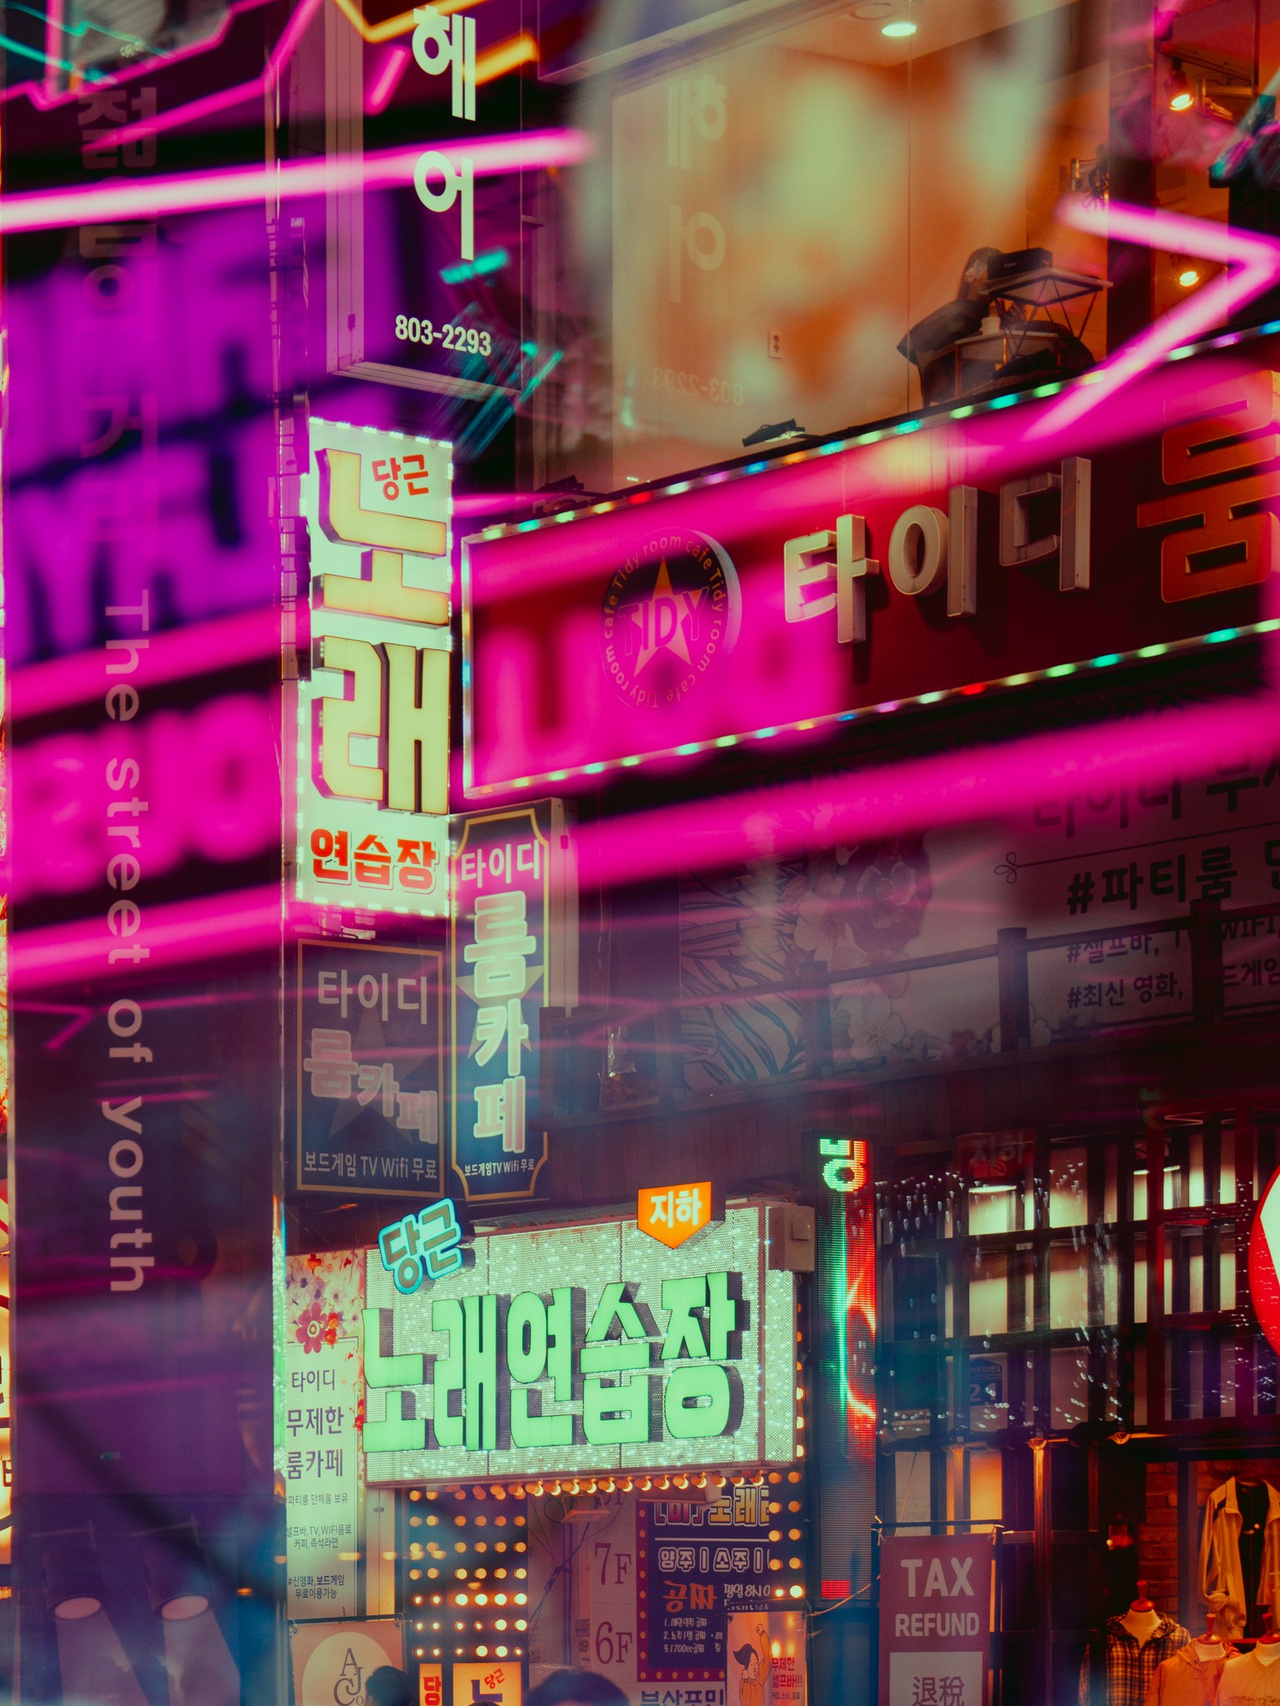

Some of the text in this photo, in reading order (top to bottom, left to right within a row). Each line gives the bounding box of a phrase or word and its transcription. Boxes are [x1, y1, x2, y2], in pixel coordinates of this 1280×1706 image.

[395, 314, 491, 356] 803-2293
[371, 454, 429, 501] 당근
[784, 456, 1091, 645] 타이디
[314, 447, 450, 816] 노래
[617, 586, 710, 656] TIDY
[309, 828, 438, 894] 연습장
[461, 839, 540, 889] 타이디
[101, 588, 155, 1293] The street of youth
[318, 969, 429, 1025] 타이디
[1067, 977, 1125, 1010] #최신
[464, 890, 537, 1154] 룸카페
[303, 1026, 440, 1146] 룸카페
[304, 1151, 438, 1182] 보드게임 TV Wifi 무료
[503, 1158, 536, 1173] Wifi 무료
[649, 1190, 703, 1228] 지하
[378, 1198, 463, 1295] 당근
[291, 1369, 336, 1393] 타이디
[361, 1272, 740, 1453] 노래연습장
[286, 1406, 344, 1437] 무제한
[286, 1449, 343, 1480] 룸카페
[594, 1542, 631, 1585] 7F
[713, 1547, 749, 1573] 소주
[900, 1557, 975, 1598] TAX
[595, 1621, 632, 1664] 6F
[895, 1612, 980, 1637] REFUND
[484, 1668, 506, 1690] 당근
